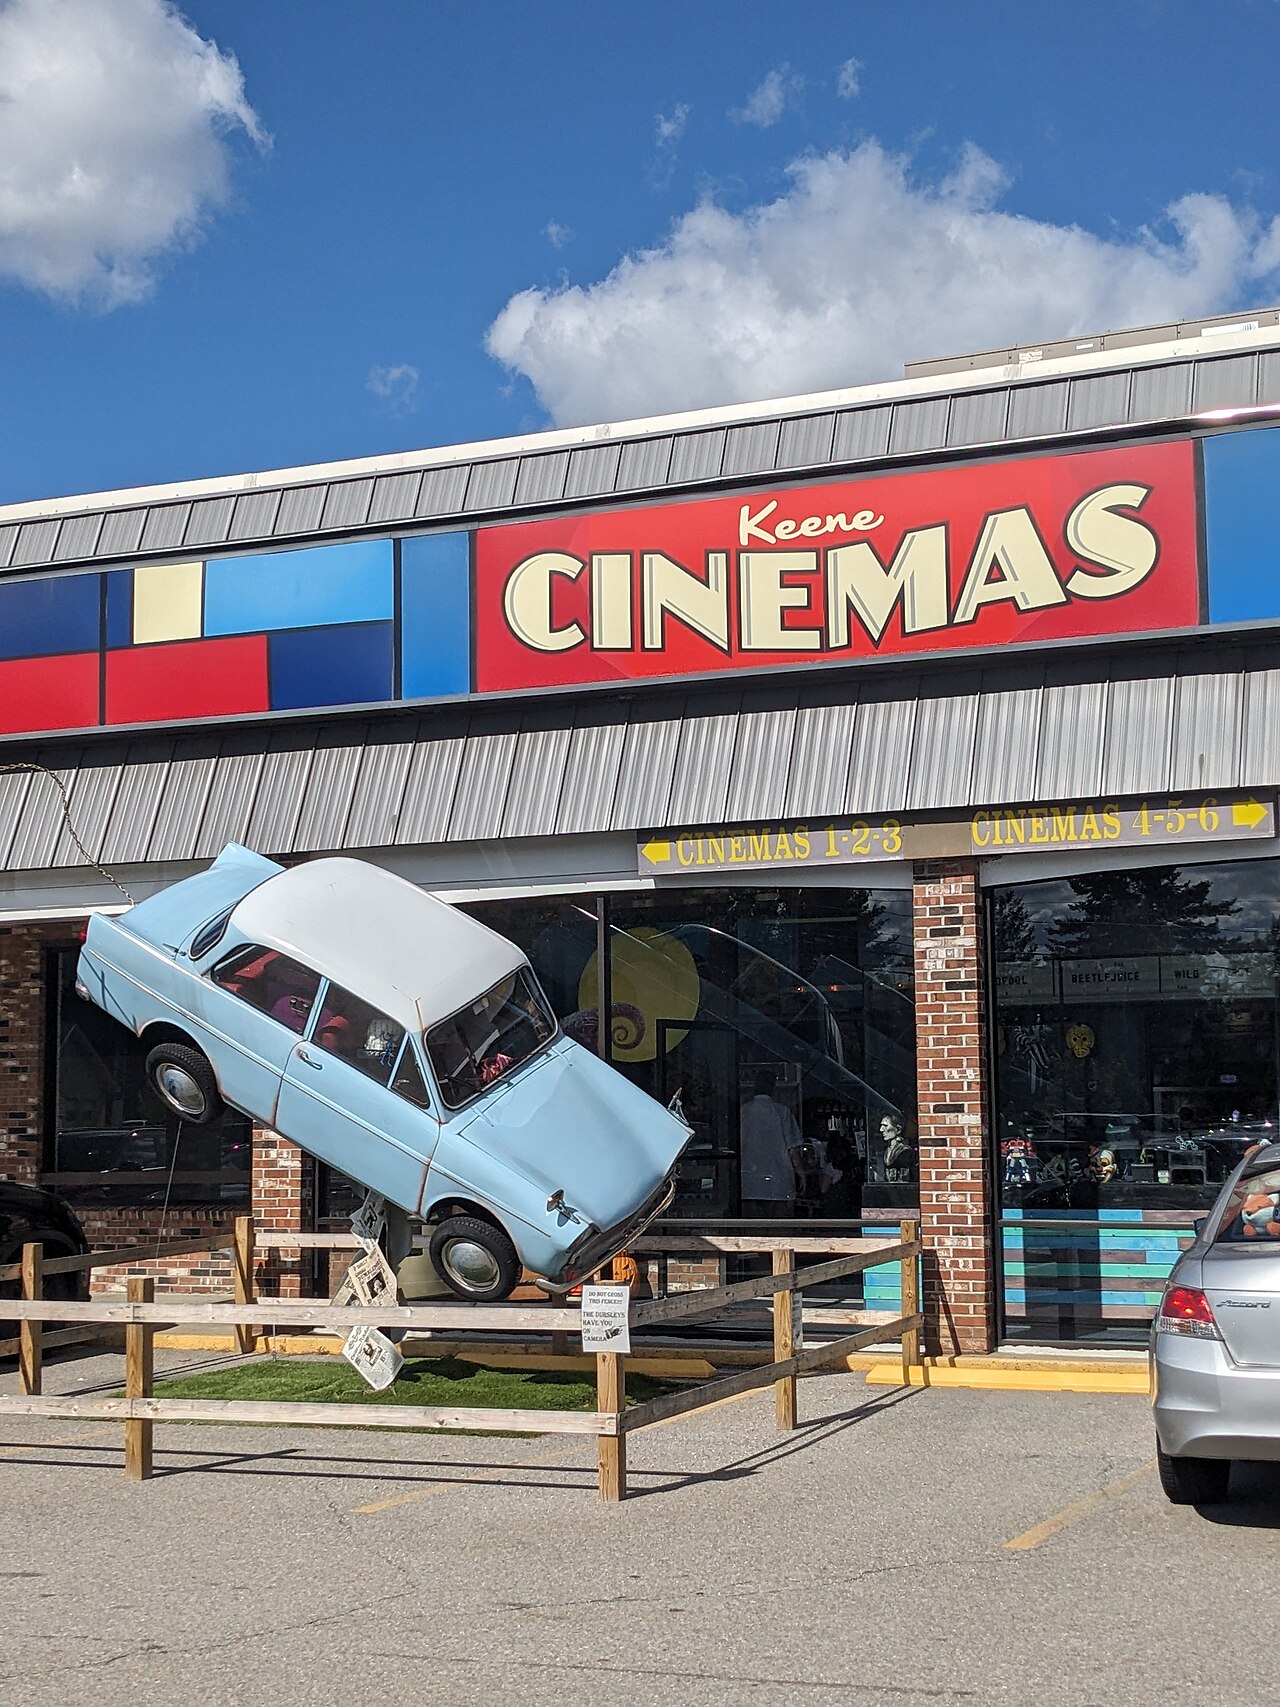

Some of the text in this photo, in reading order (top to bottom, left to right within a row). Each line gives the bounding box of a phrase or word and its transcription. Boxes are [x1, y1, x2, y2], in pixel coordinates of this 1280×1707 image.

[738, 499, 885, 547] Keene
[503, 482, 1159, 656] CINEMAS
[675, 819, 904, 867] CINEMAS 1-2-3
[973, 798, 1220, 847] CINEMAS 4-5-6
[1072, 972, 1140, 983] BEETLEJUICE
[1216, 1300, 1272, 1308] Accord
